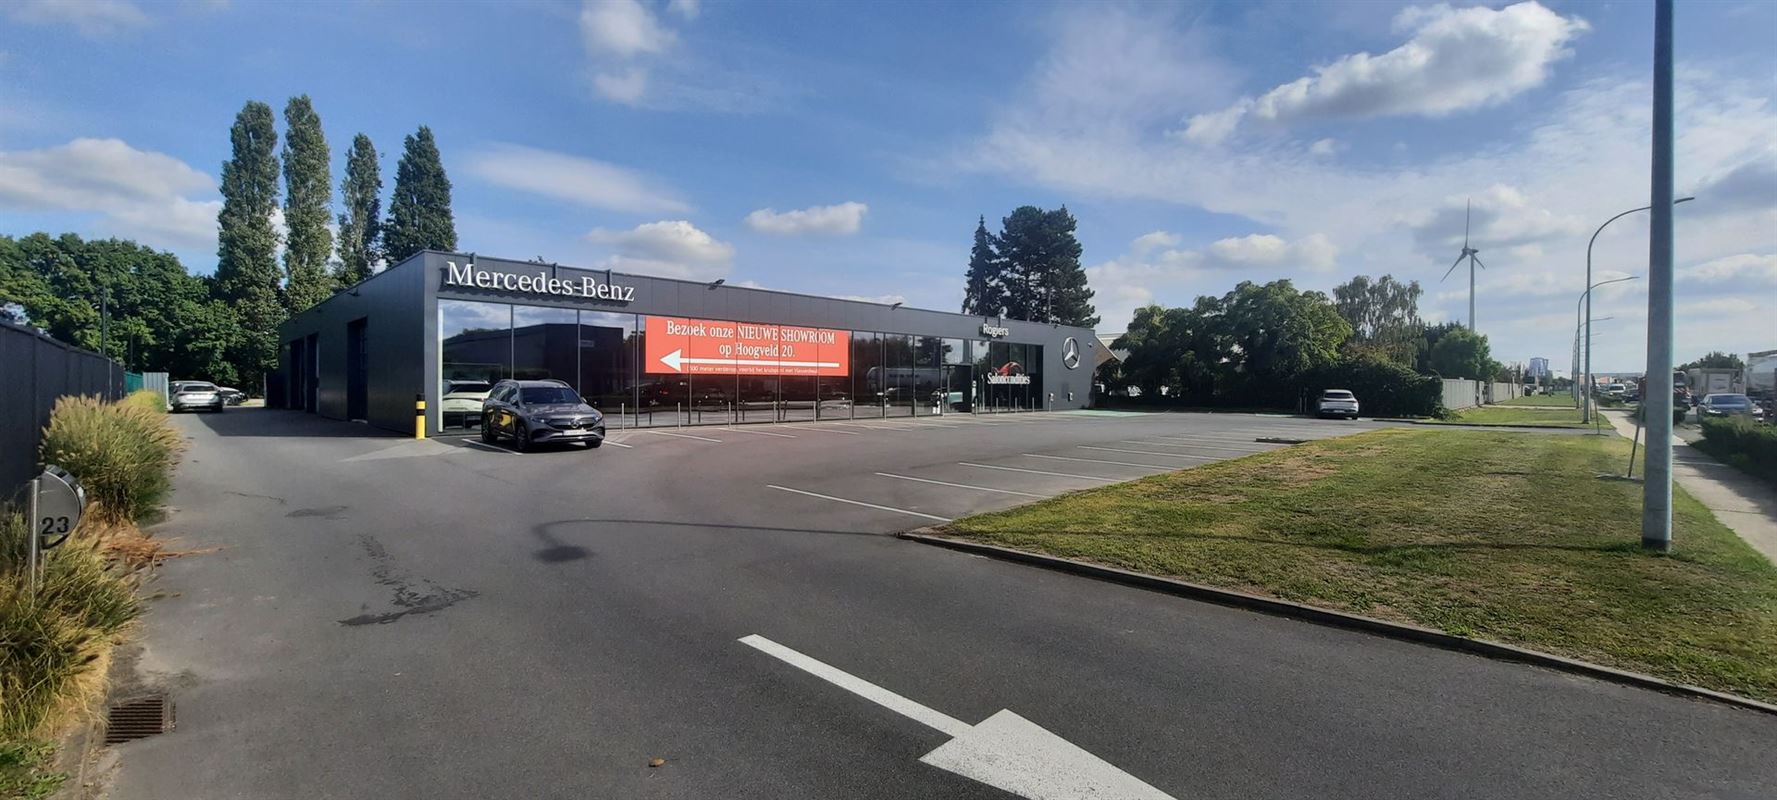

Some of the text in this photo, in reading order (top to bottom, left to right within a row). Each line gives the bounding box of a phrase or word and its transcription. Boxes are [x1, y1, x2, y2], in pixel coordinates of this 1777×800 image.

[446, 261, 635, 302] Mercedes-Benz
[666, 320, 835, 344] Bezoek onze NIEUWE SHOWROOM
[982, 323, 1009, 338] Rogiers
[719, 342, 796, 359] op Hoogveld 20.
[41, 516, 69, 535] 23
